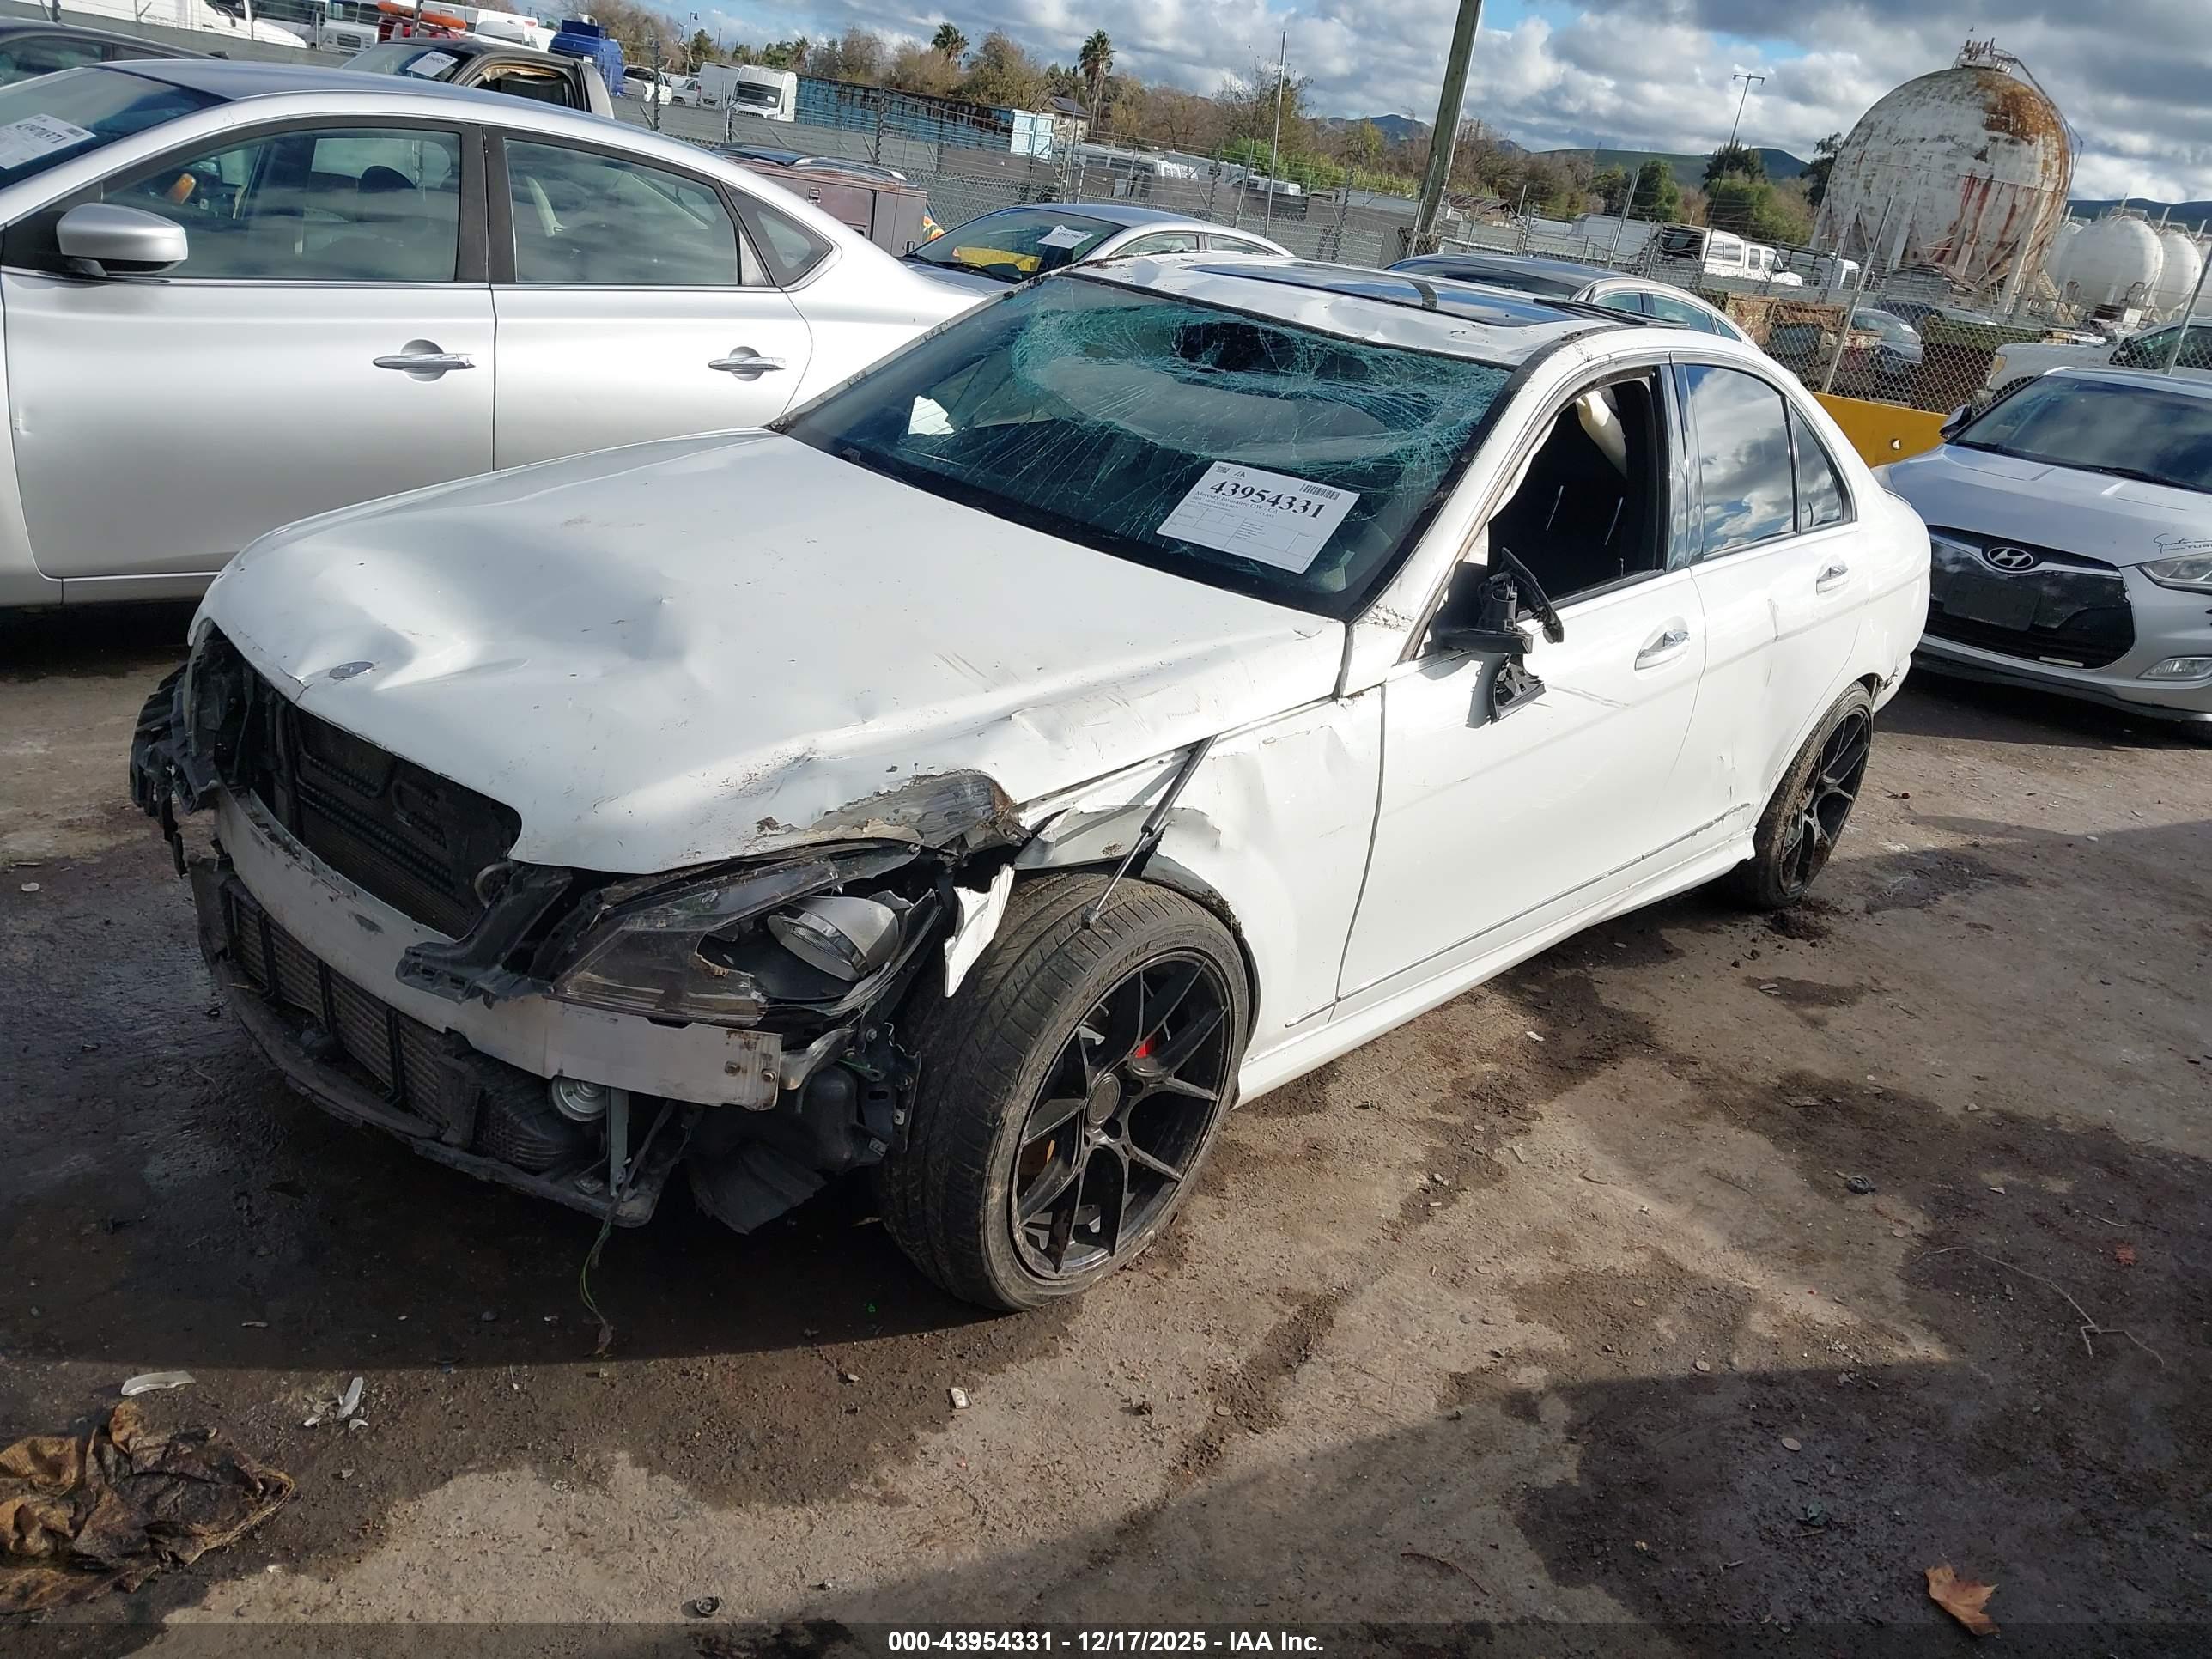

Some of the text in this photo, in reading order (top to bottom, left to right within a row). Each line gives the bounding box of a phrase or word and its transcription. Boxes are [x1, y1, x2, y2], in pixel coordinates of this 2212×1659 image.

[1195, 490, 1221, 501] Mercury
[1221, 495, 1249, 507] Insurance
[1210, 480, 1327, 520] 43954331
